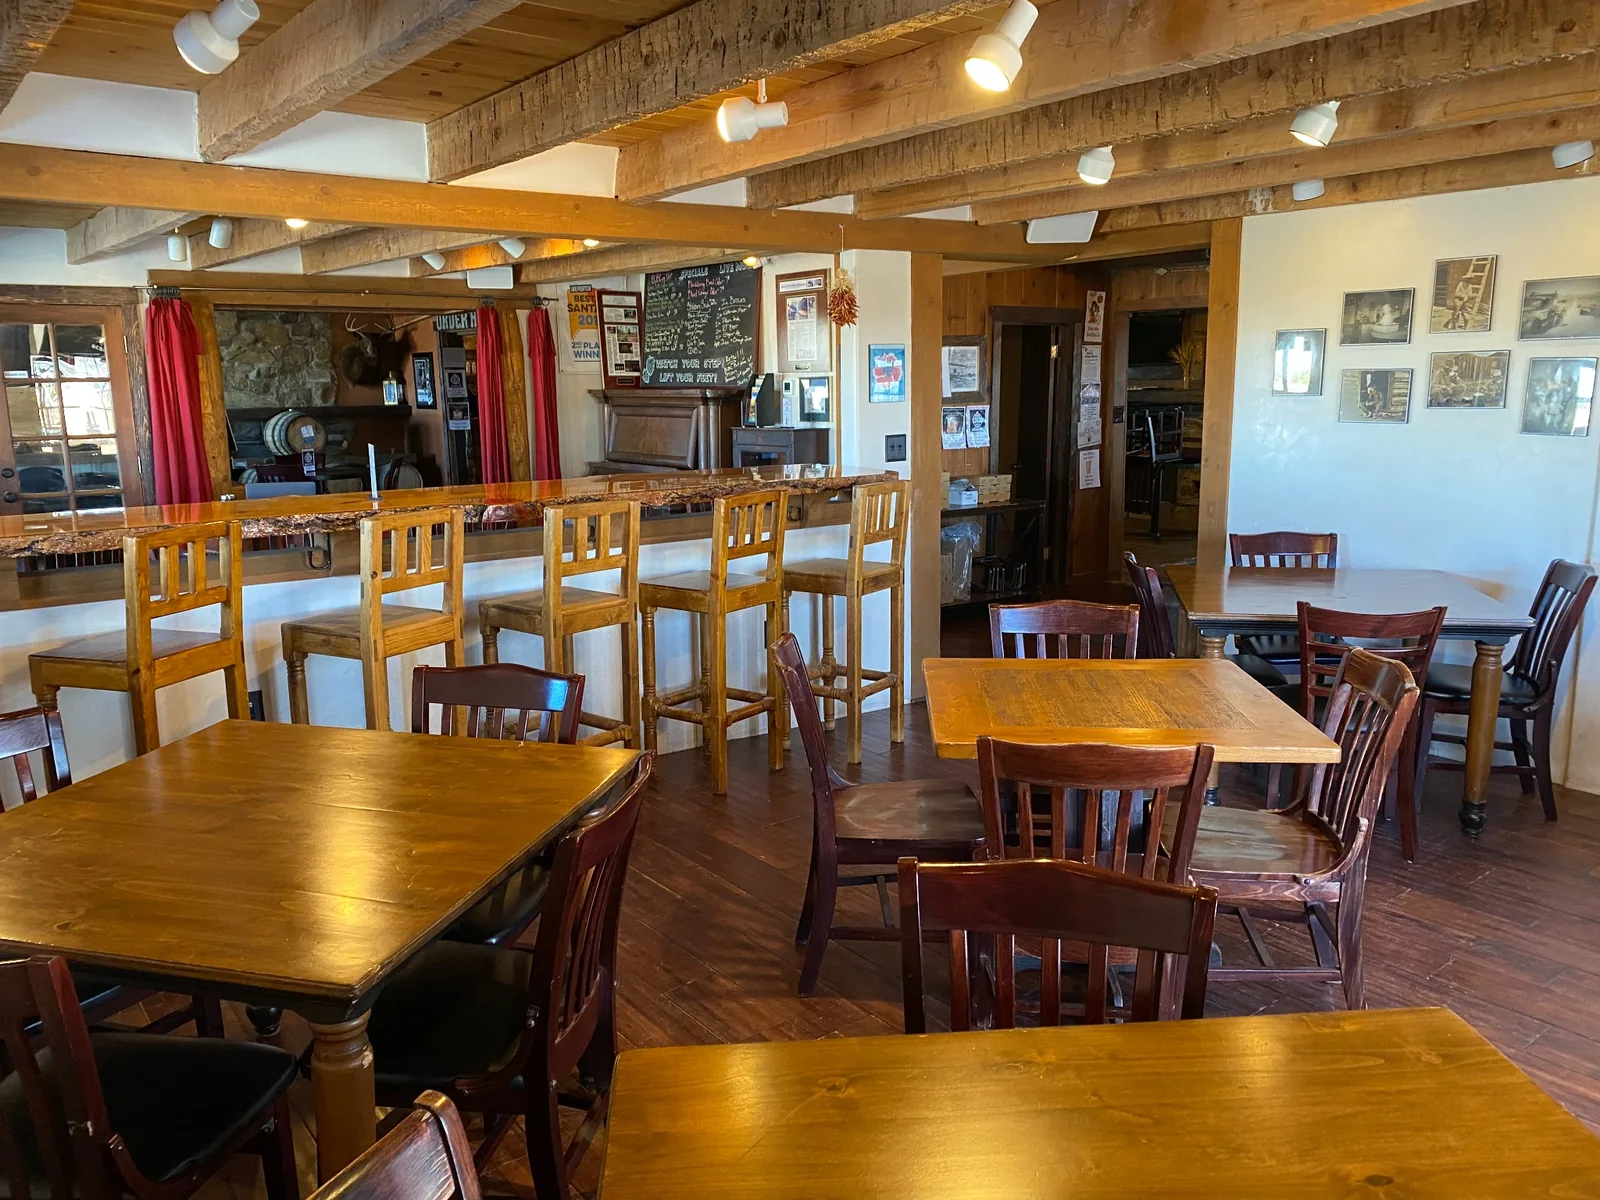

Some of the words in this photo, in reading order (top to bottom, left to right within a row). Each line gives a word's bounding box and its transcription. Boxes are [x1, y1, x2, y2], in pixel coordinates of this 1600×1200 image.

[680, 267, 708, 279] SPECIALS
[719, 262, 734, 274] LIVE
[573, 294, 596, 303] BEST
[436, 313, 468, 331] ORDER
[583, 341, 600, 350] PLA
[573, 351, 600, 359] WINN
[656, 359, 678, 369] WATCH
[681, 359, 700, 369] YOUR
[659, 373, 674, 383] LIFT
[675, 373, 694, 383] YOUR
